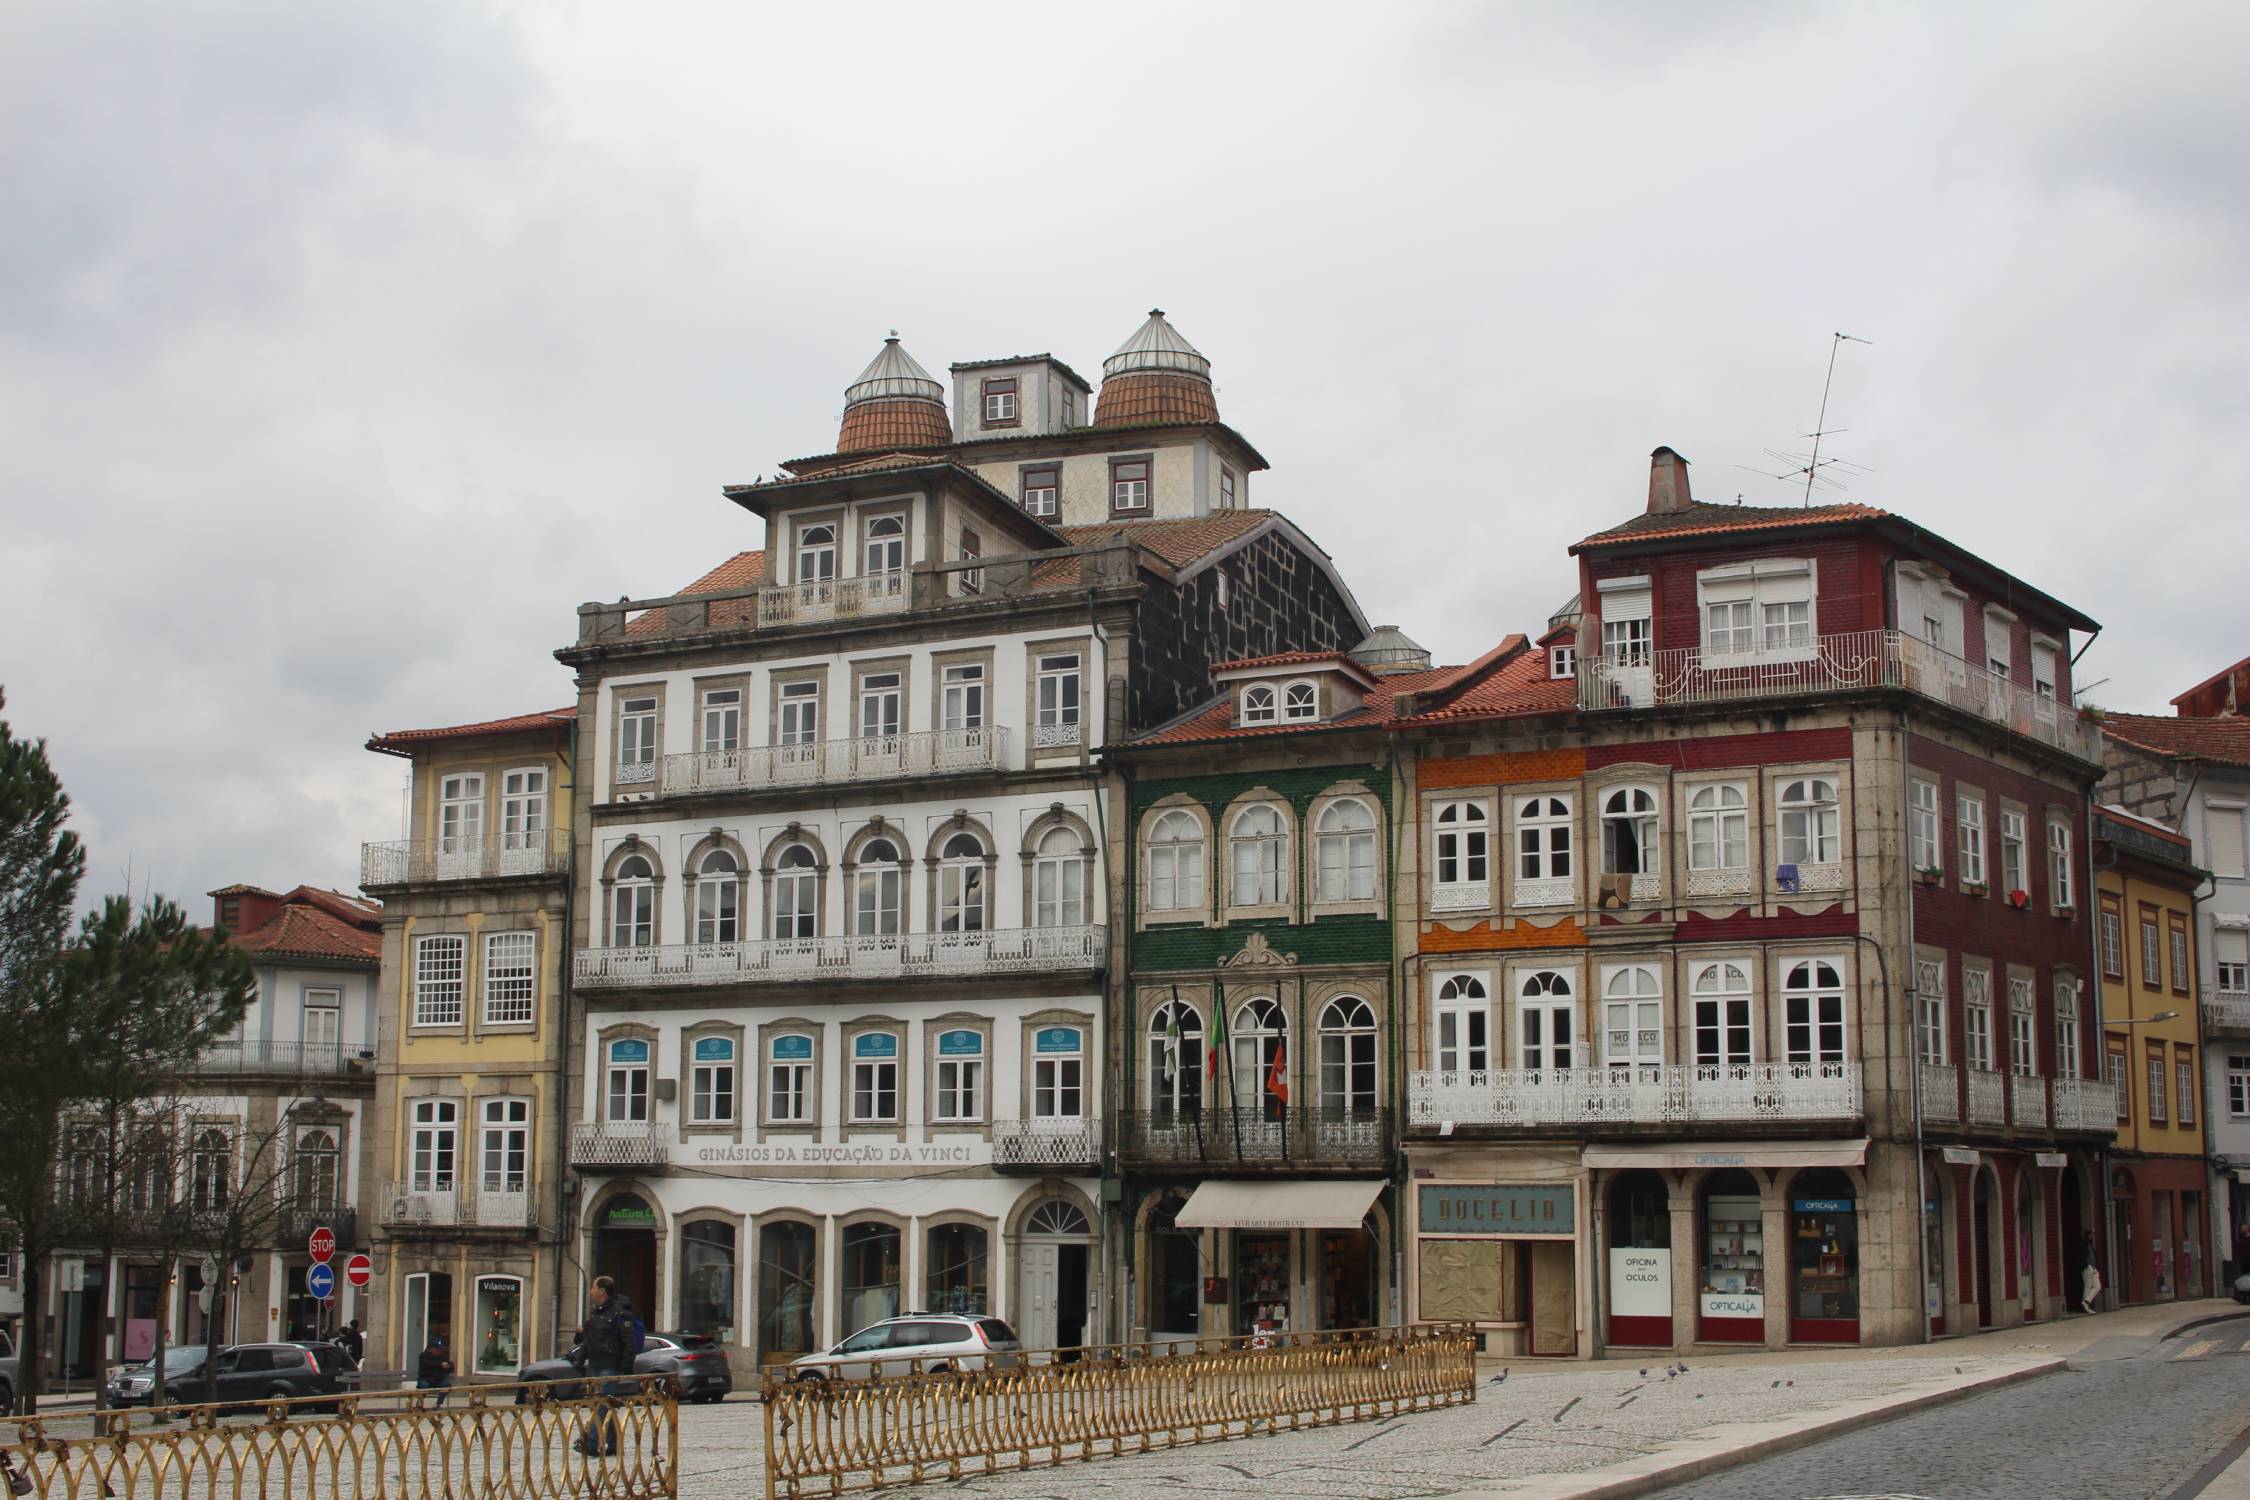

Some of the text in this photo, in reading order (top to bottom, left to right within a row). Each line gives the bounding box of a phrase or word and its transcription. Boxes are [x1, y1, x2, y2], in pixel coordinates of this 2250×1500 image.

[1614, 1032, 1656, 1042] MOACO
[698, 1145, 971, 1164] GINÁSIOS DA EDUCAÇÃO DA VINCI
[1439, 1198, 1555, 1220] DOCELIA
[1234, 1219, 1305, 1228] LIVRARIA BERTRAND
[312, 1239, 334, 1252] STOP
[1625, 1258, 1658, 1266] OFICINA
[483, 1280, 517, 1291] Vilanova
